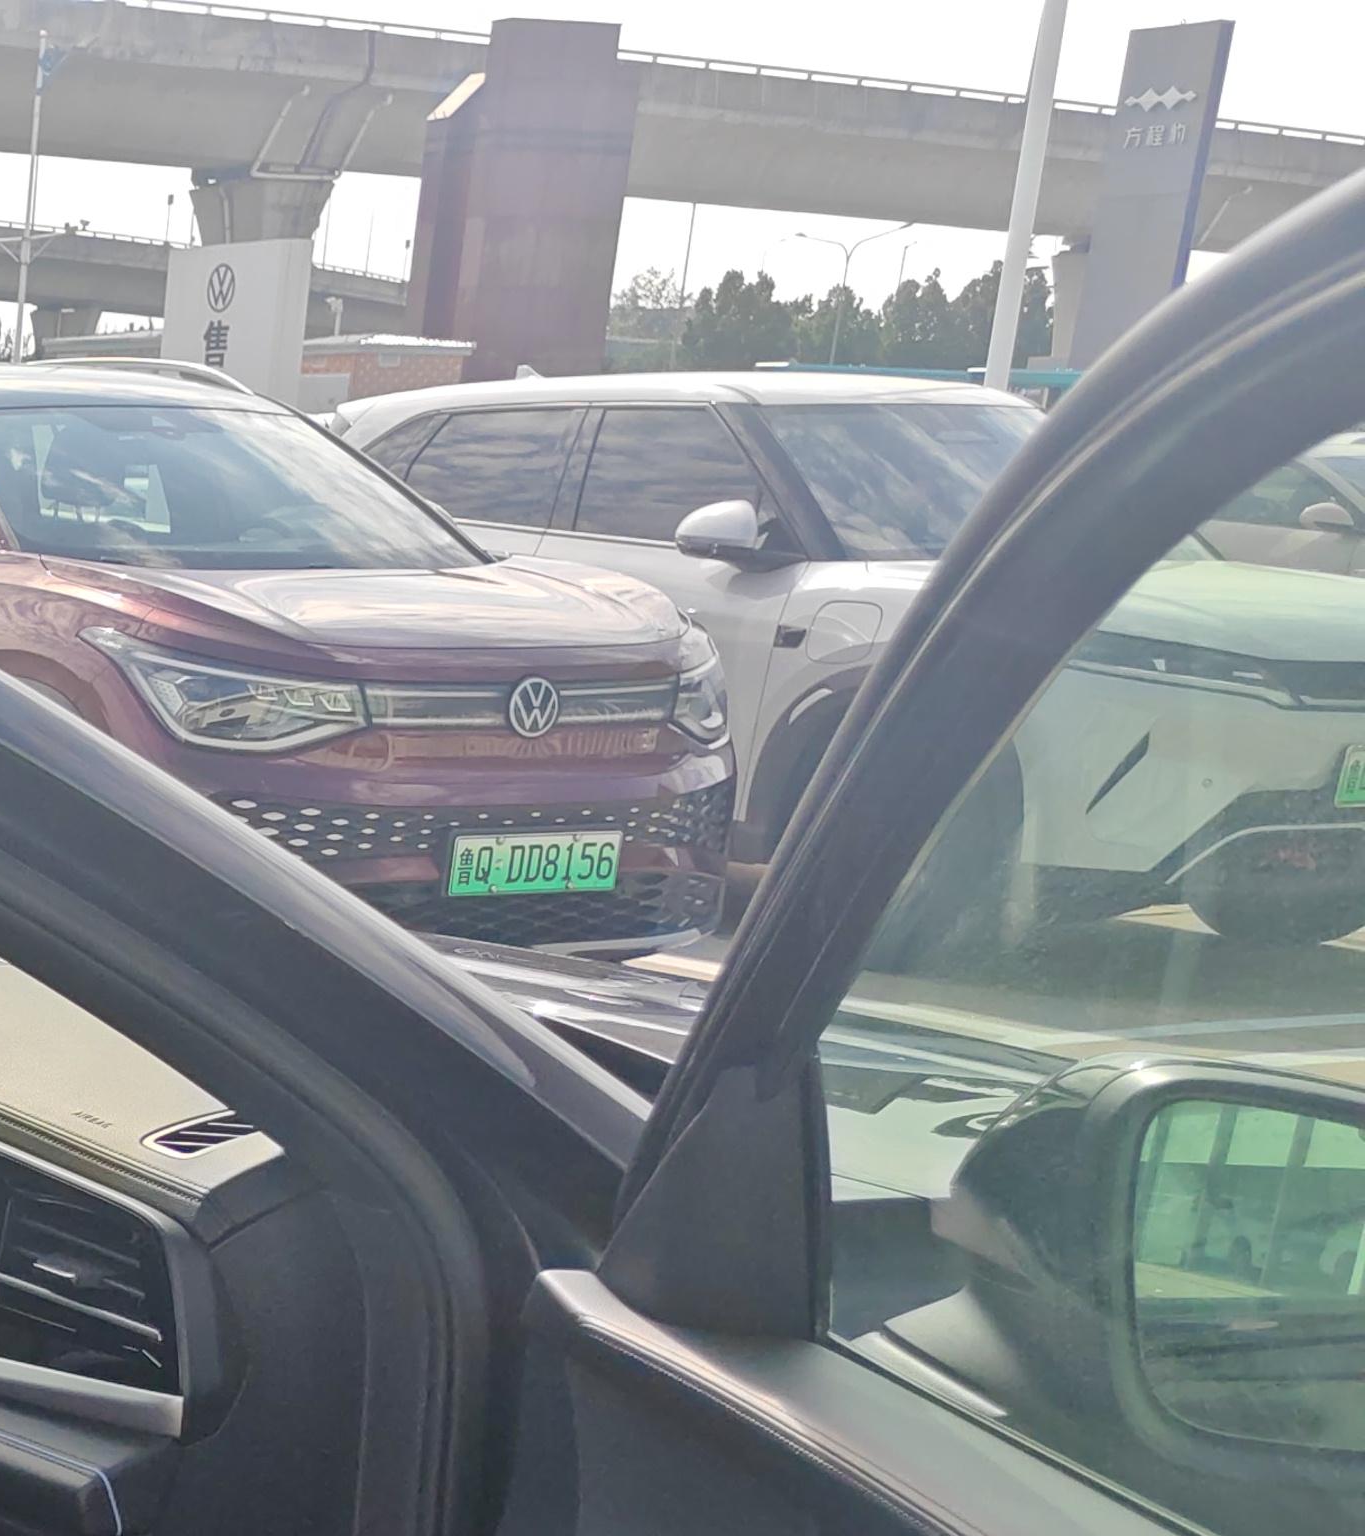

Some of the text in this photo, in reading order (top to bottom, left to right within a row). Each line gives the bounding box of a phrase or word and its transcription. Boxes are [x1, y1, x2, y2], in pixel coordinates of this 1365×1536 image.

[1123, 121, 1186, 149] 方程豹
[203, 320, 229, 367] 售
